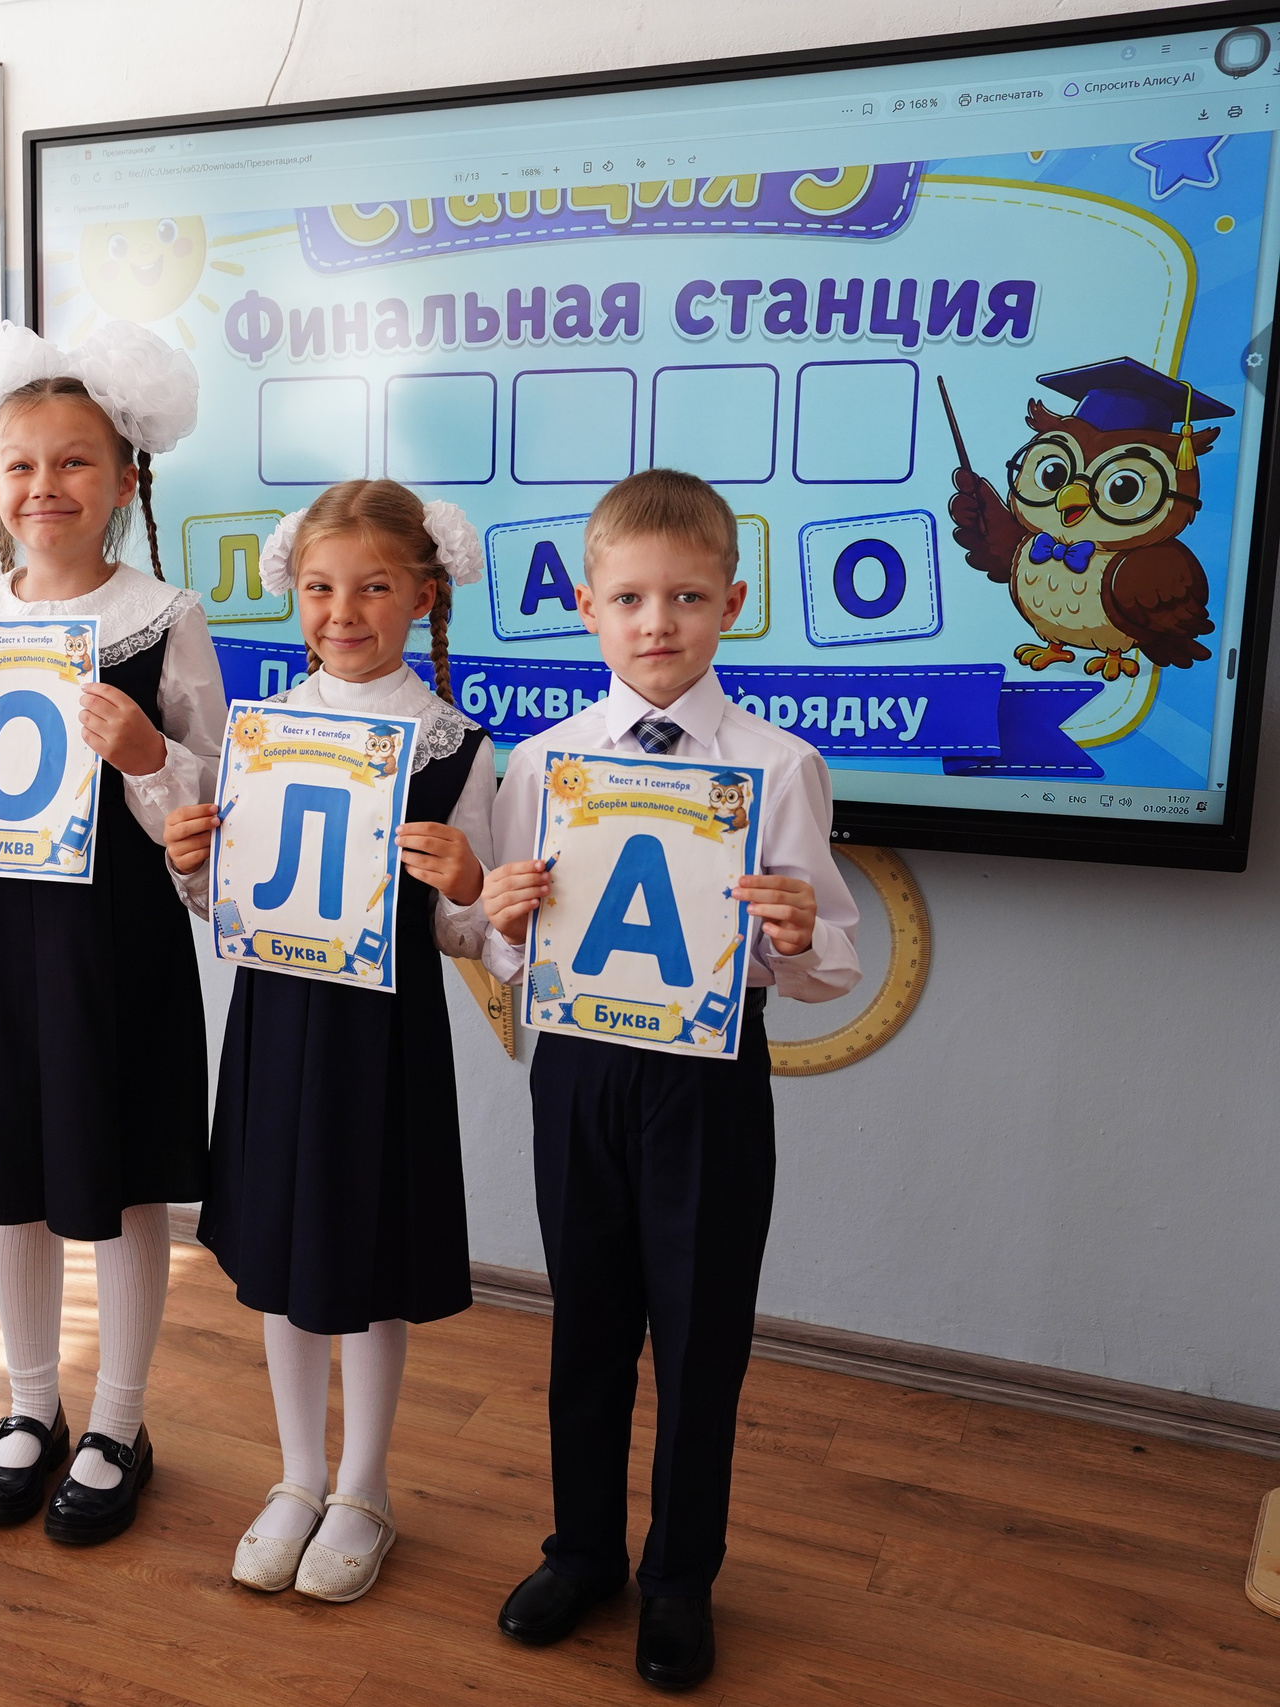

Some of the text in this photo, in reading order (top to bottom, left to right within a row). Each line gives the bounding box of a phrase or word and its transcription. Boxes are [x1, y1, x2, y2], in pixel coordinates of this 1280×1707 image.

[976, 88, 1043, 103] Распечатать
[1084, 80, 1140, 94] Спросить
[1143, 73, 1181, 89] Алису
[102, 144, 156, 158] Презентация.pdf
[225, 276, 1036, 364] Финальная станция
[211, 534, 263, 602] Л
[520, 540, 578, 616] А
[27, 636, 53, 645] сентября
[13, 655, 45, 663] школьное
[46, 657, 67, 668] солнце
[724, 694, 929, 742] орядку
[282, 725, 303, 735] Квест
[318, 730, 351, 740] сентября
[263, 747, 364, 768] Соберём школьное солнце
[608, 774, 633, 785] Квест
[651, 780, 691, 791] сентября
[587, 799, 708, 821] Соберём школьное солнце
[1068, 795, 1087, 804] ENG
[1143, 805, 1189, 815] 01.09.2026
[1168, 795, 1190, 804] 11:07
[252, 783, 351, 921] Л
[571, 833, 694, 988] А
[271, 939, 328, 963] Буква
[595, 1004, 660, 1031] Буква
